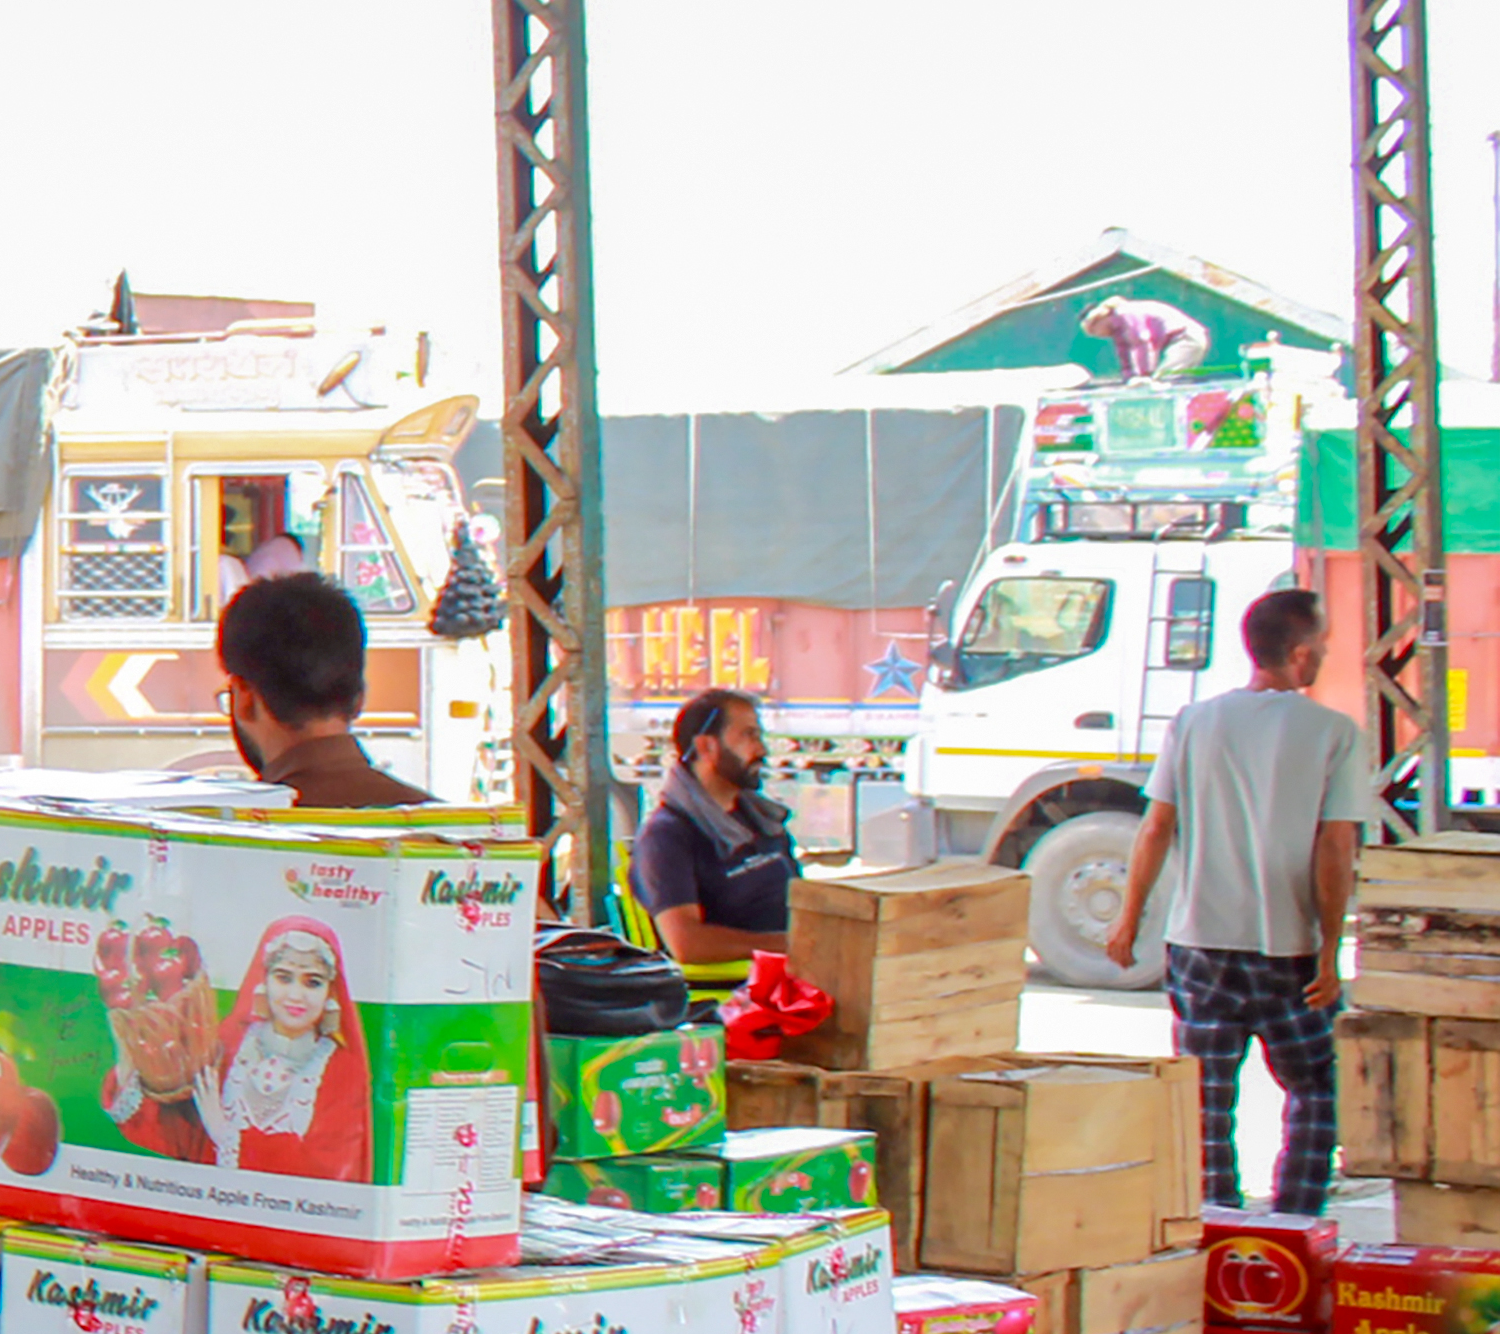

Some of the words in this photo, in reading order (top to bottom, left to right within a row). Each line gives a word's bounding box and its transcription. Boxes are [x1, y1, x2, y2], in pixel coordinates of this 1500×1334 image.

[309, 863, 354, 882] tasty
[312, 884, 382, 904] healthy
[2, 915, 91, 945] APPLES
[70, 1164, 120, 1189] Healthy
[124, 1173, 135, 1188] &
[136, 1175, 204, 1200] Nutritious
[207, 1185, 250, 1208] Apple
[253, 1192, 292, 1212] From
[295, 1195, 364, 1220] Kashmir
[1336, 1282, 1447, 1315] Kashmir
